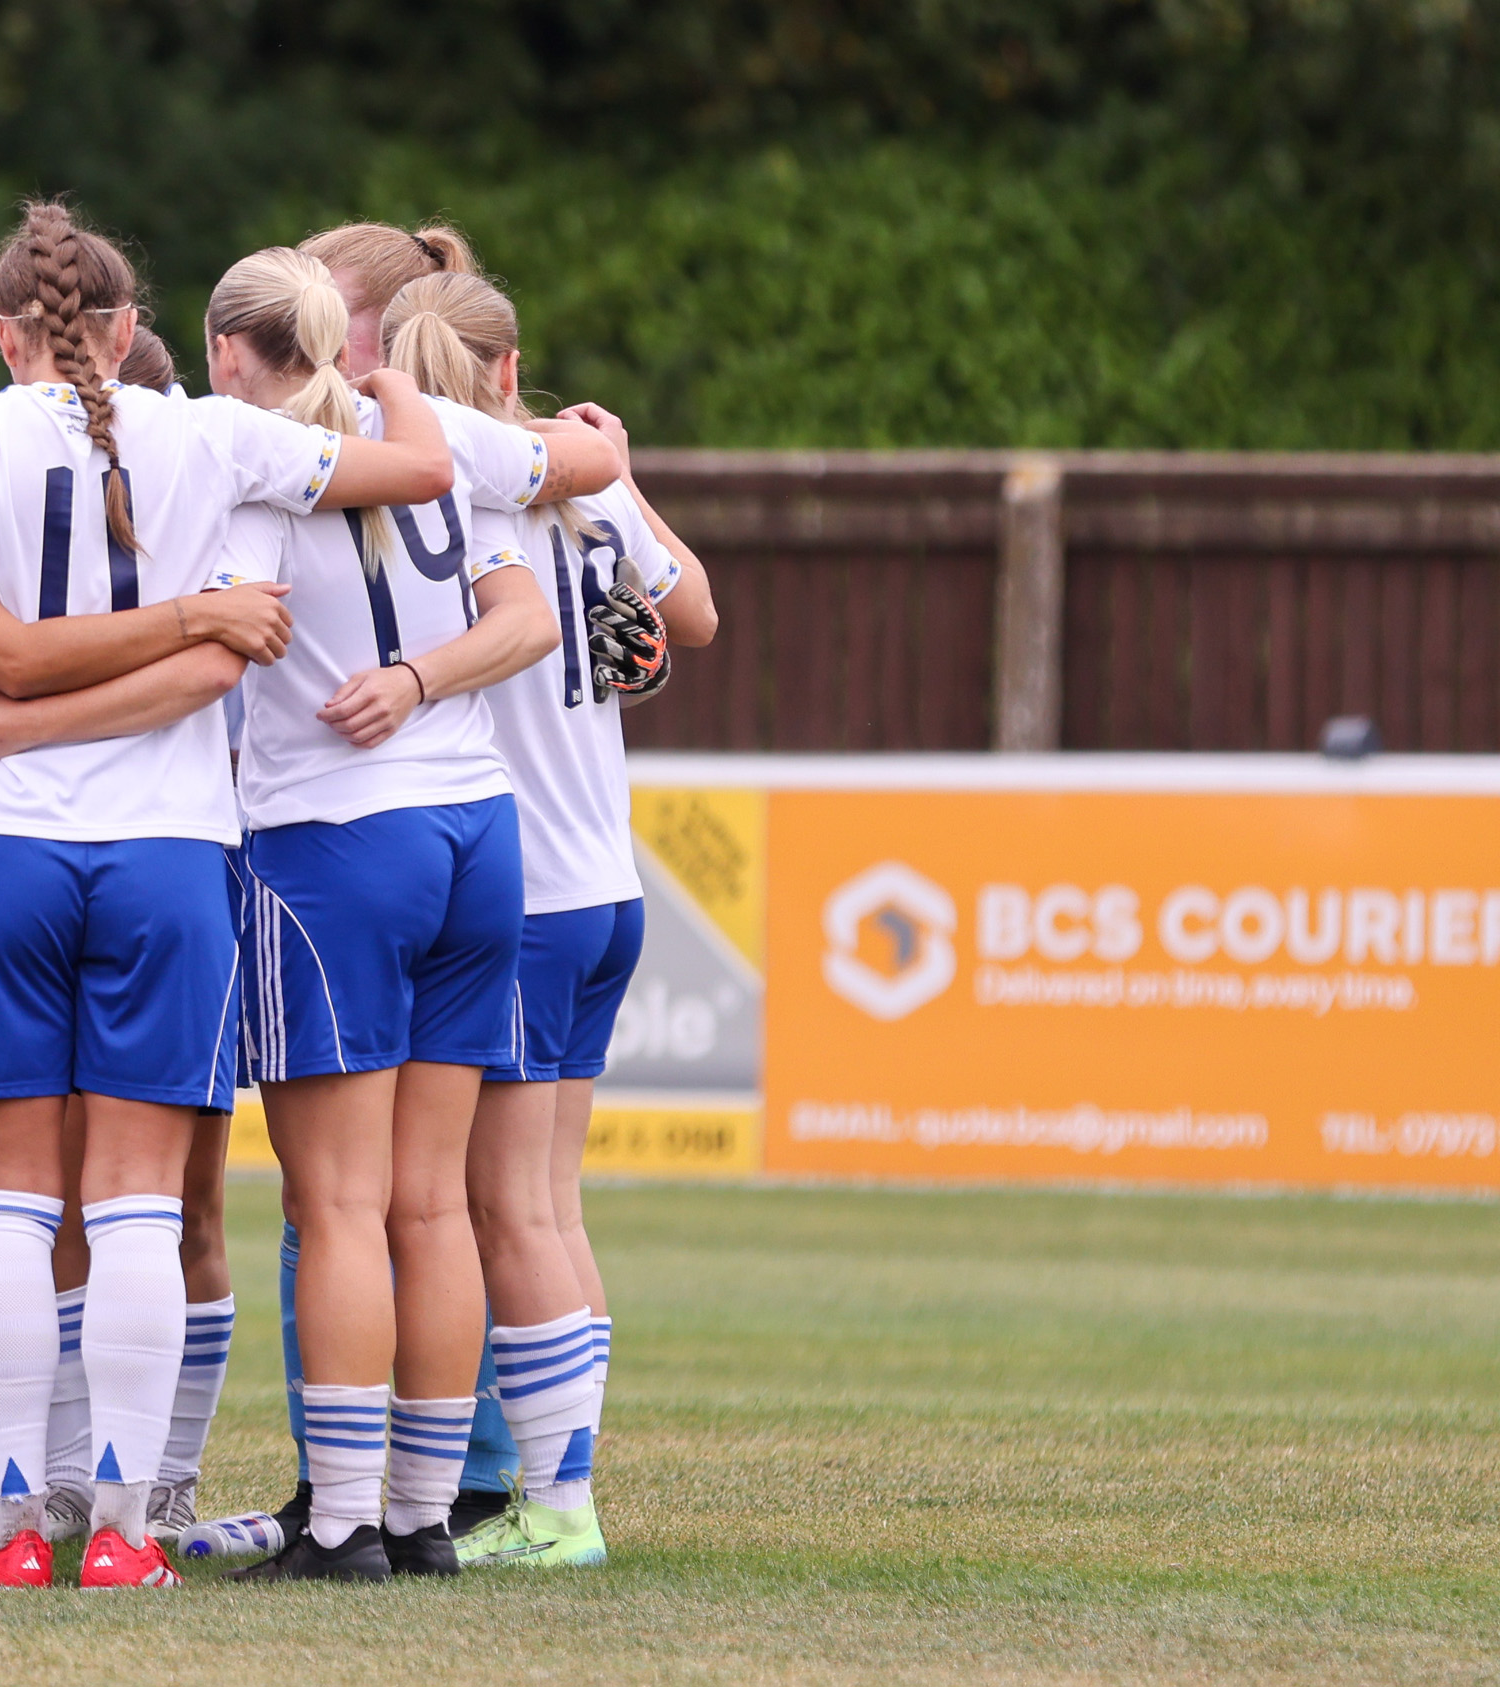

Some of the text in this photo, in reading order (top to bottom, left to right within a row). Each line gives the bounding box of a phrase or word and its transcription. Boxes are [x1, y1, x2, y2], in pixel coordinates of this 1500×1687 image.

[37, 464, 140, 621] 11
[976, 883, 1143, 962] BCS
[975, 969, 1122, 1006] Delivered
